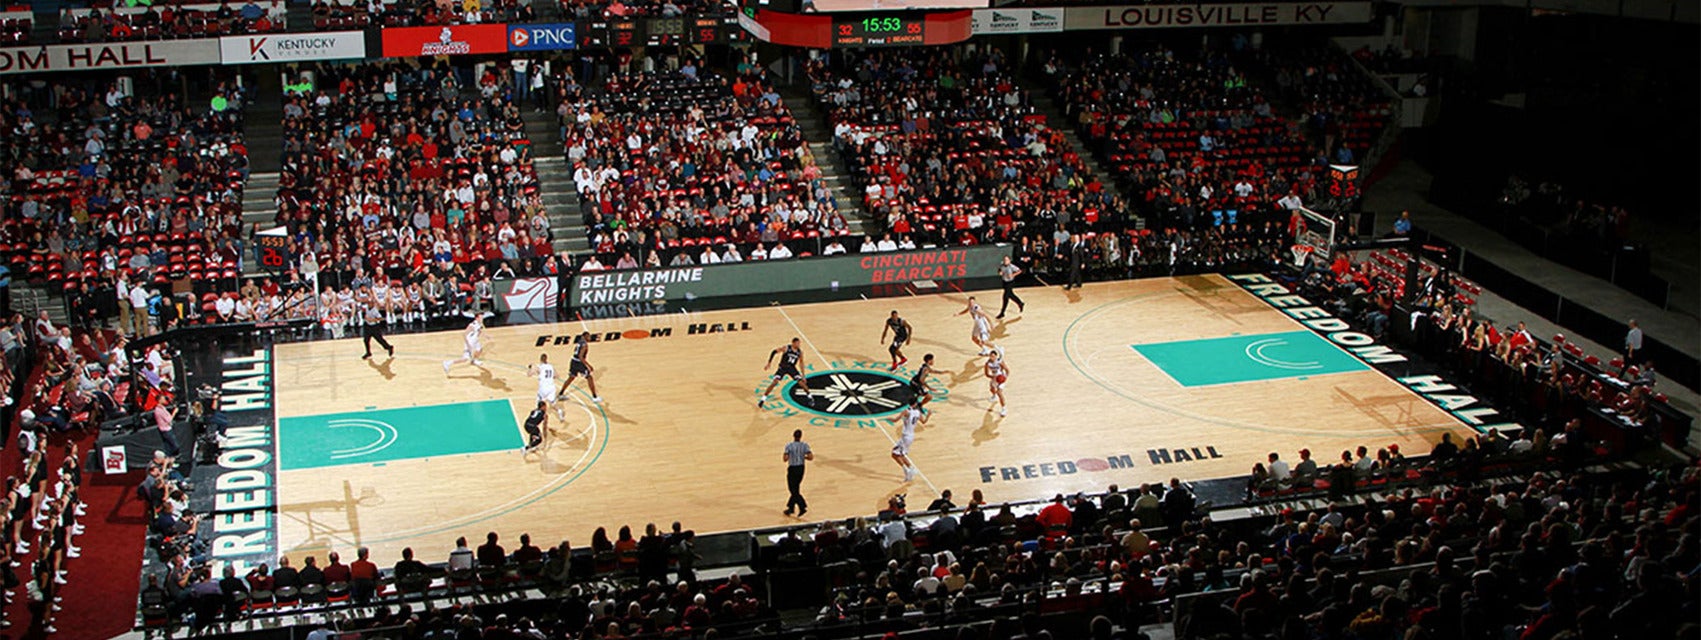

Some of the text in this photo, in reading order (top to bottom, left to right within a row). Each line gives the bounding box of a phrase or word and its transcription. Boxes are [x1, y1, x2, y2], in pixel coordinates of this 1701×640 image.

[862, 17, 901, 32] 15:53
[1105, 5, 1333, 26] LOUISVILLE KY
[532, 28, 573, 45] PNC
[838, 25, 853, 35] 32
[907, 23, 922, 33] 55
[277, 38, 336, 50] KENTUCKY
[67, 44, 166, 68] HALL
[263, 247, 283, 266] 26
[861, 250, 967, 269] CINCINNATI
[580, 268, 703, 289] BELLARMINE
[872, 264, 967, 283] BEARCATS
[580, 285, 665, 304] KNIGHTS
[1231, 272, 1408, 364] FREEDOM
[688, 321, 753, 335] HALL
[210, 349, 272, 580] FREEDOM HALL
[1147, 446, 1224, 465] HALL
